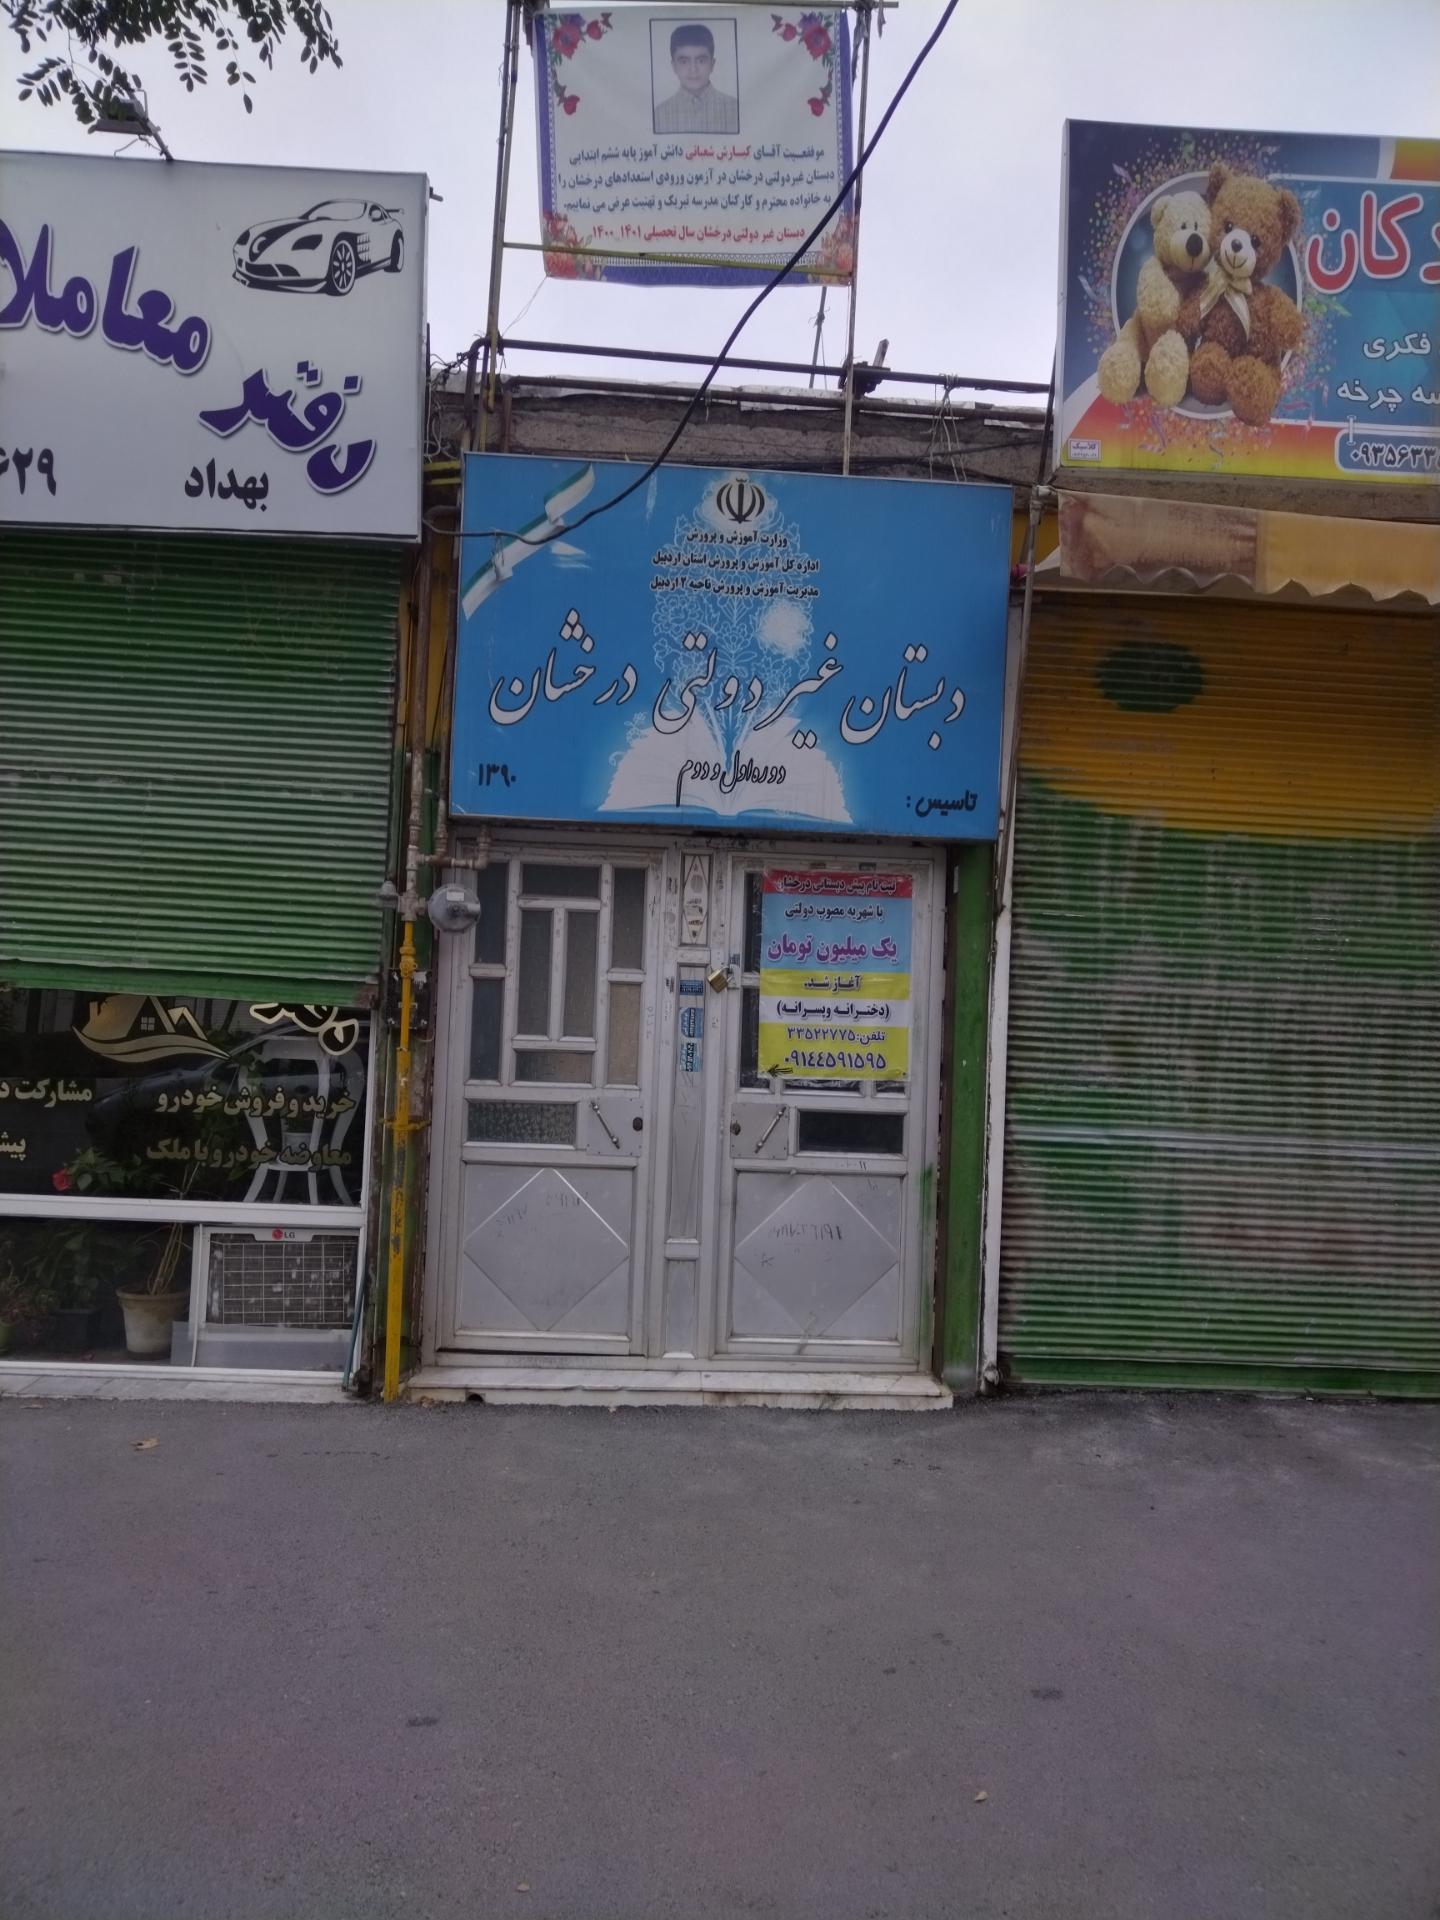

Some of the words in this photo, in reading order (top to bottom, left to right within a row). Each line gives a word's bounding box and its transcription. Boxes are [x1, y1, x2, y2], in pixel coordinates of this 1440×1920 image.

[601, 147, 620, 161] ششم
[621, 146, 637, 162] پایه
[638, 144, 658, 162] آموز
[660, 144, 684, 161] دانش
[753, 144, 781, 161] آقای
[558, 173, 567, 189] را
[568, 173, 603, 190] درخشان
[656, 171, 685, 186] ورودی
[686, 167, 714, 186] آزمون
[716, 170, 727, 185] در
[728, 168, 763, 186] درخشان
[806, 168, 835, 185] دبستان
[592, 202, 606, 213] می
[608, 196, 630, 212] عرض
[632, 195, 655, 210] تهنیت
[657, 200, 663, 210] و
[664, 194, 690, 210] تبریک
[692, 196, 719, 210] مدرسه
[720, 193, 753, 210] کارکنان
[755, 200, 760, 210] و
[761, 197, 788, 211] محترم
[789, 191, 821, 209] خانواده
[822, 193, 832, 206] به
[643, 223, 677, 242] تحصیلی
[678, 225, 696, 242] سال
[696, 224, 732, 242] درخشان
[733, 225, 759, 243] دولتی
[762, 227, 774, 242] غیر
[776, 225, 806, 243] دبستان
[1362, 332, 1432, 361] فکری
[1336, 379, 1403, 413] چرخه
[199, 360, 376, 493] دفتر
[184, 458, 269, 512] بهداد
[686, 528, 717, 545] پرورش
[719, 534, 724, 544] و
[726, 530, 758, 545] آموزش
[760, 534, 788, 548] وزارت
[652, 550, 681, 566] اردبیل
[682, 552, 707, 567] استان
[708, 555, 739, 570] پرورش
[741, 560, 746, 570] و
[747, 556, 779, 572] آموزش
[781, 558, 795, 573] کل
[797, 559, 819, 574] اداره
[650, 574, 679, 591] اردبیل
[681, 577, 687, 588] ۲
[689, 578, 712, 591] ناحیه
[713, 581, 744, 596] پرورش
[745, 586, 751, 596] و
[752, 581, 784, 597] آموزش
[786, 583, 819, 600] مدیریت
[489, 607, 638, 725] درخشان
[652, 631, 764, 734] دولتی
[753, 632, 843, 749] غیر
[840, 643, 966, 750] دبستان
[478, 763, 517, 788] ۱۳۹۰
[710, 762, 721, 781] و
[719, 750, 754, 795] اول
[751, 764, 787, 785] دوره
[676, 759, 711, 808] دوم
[812, 877, 845, 894] دبستانی
[866, 879, 879, 895] نام
[880, 878, 897, 896] ثبت
[785, 902, 814, 919] دولتی
[816, 906, 845, 919] مصوب
[847, 904, 874, 920] شهریه
[876, 904, 883, 919] با
[767, 933, 814, 961] تومان
[816, 936, 867, 962] میلیون
[871, 936, 898, 963] یک
[832, 975, 861, 992] آغاز
[14, 1078, 93, 1108] مشارکت
[155, 1085, 224, 1113] خودرو
[223, 1085, 286, 1118] فروش
[286, 1097, 299, 1118] و
[302, 1091, 355, 1119] خرید
[146, 1138, 191, 1161] ملک
[193, 1139, 210, 1167] با
[208, 1141, 277, 1169] خودرو
[278, 1142, 351, 1172] معاوضه
[284, 1231, 296, 1239] LG
